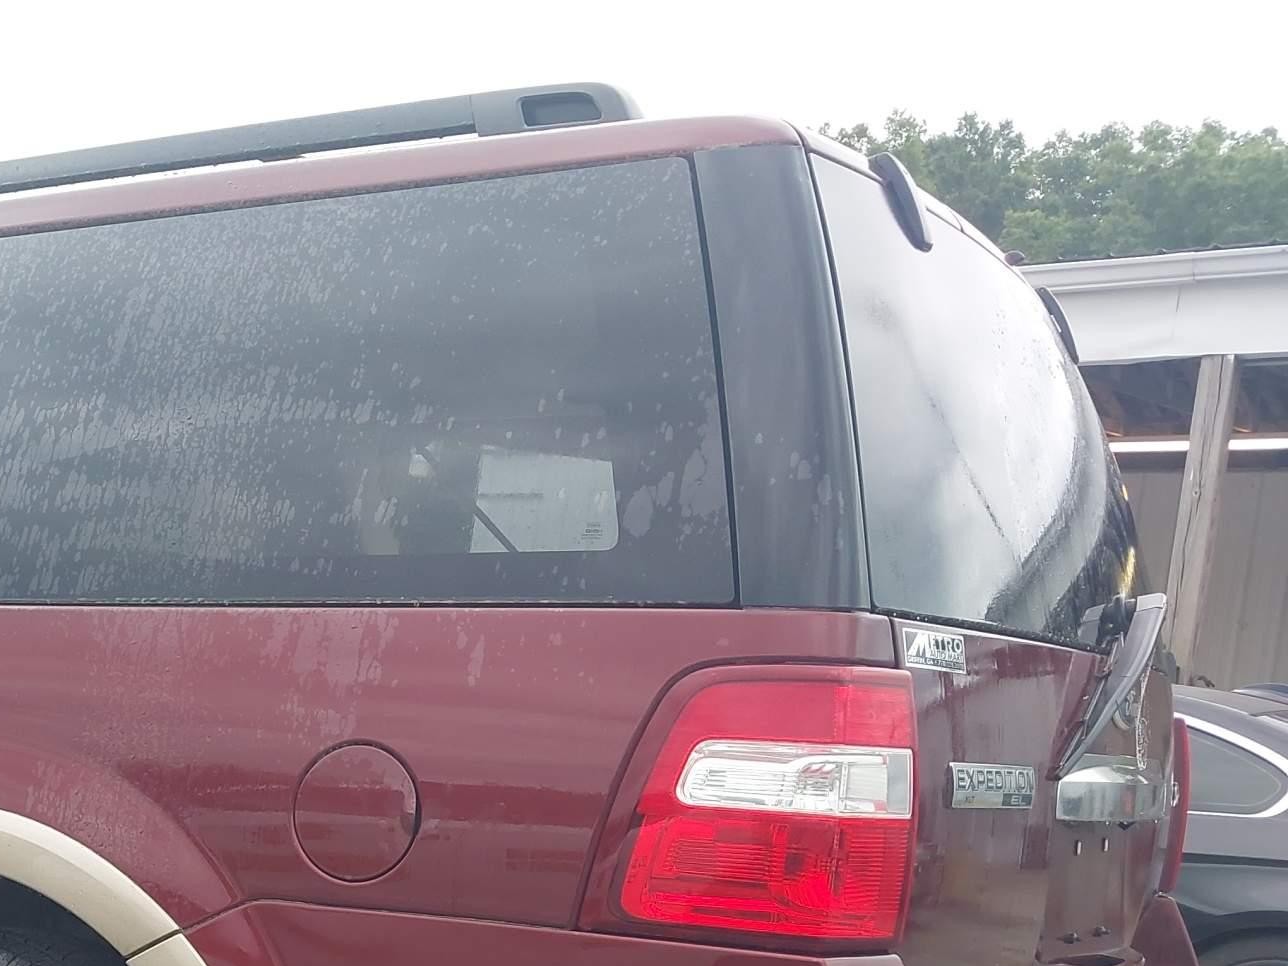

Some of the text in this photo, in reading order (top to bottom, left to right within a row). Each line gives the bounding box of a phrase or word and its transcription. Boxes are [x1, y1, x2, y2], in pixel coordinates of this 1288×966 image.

[907, 632, 963, 657] METRO
[956, 768, 1034, 793] EXPEDITION
[1011, 795, 1026, 805] EL
